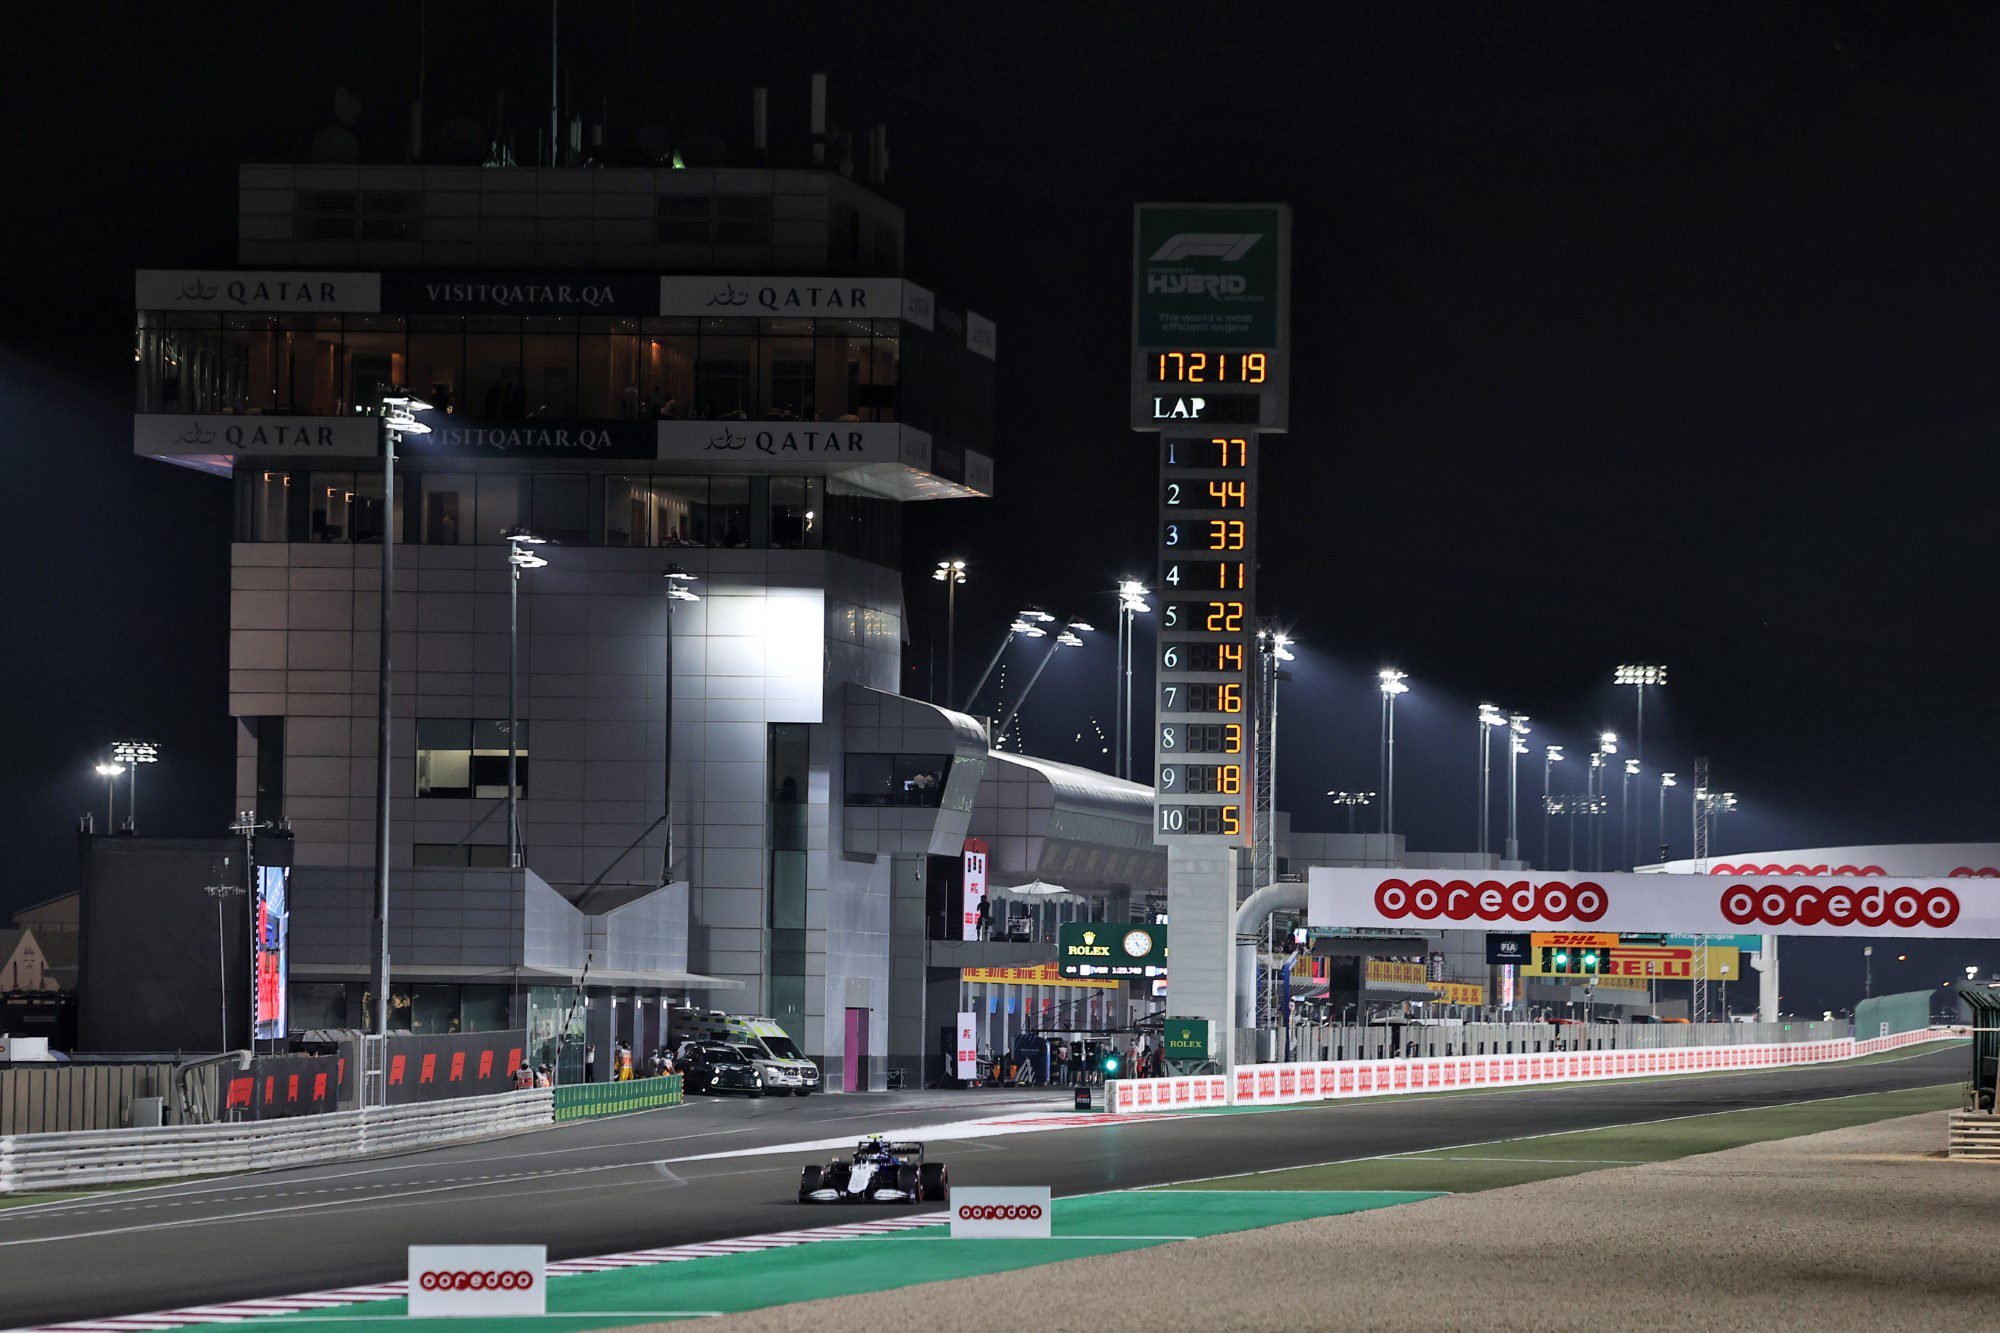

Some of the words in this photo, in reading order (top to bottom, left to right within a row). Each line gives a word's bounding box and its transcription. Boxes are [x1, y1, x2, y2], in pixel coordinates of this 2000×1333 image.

[227, 281, 337, 305] QATAR
[425, 282, 615, 305] VISITQATAR.QA
[758, 287, 867, 310] QATAR
[1148, 274, 1246, 301] HYBRID
[1153, 397, 1206, 418] LAP
[225, 425, 334, 448] QATAR
[424, 428, 612, 450] VISITQATAR.QA
[755, 431, 864, 454] QATAR
[1168, 443, 1176, 464] 1
[1212, 438, 1246, 467] 77
[1167, 484, 1180, 504] 2
[1209, 481, 1245, 508] 44
[1166, 525, 1178, 545] 3
[1210, 520, 1244, 550] 33
[1165, 565, 1180, 586] 4
[1220, 562, 1244, 589] 11
[1165, 606, 1177, 626] 5
[1207, 602, 1243, 631] 22
[1164, 647, 1177, 667] 6
[1218, 644, 1242, 670] 14
[1164, 687, 1177, 708] 7
[1218, 684, 1241, 713] 16
[1163, 728, 1175, 748] 8
[1225, 724, 1241, 754] 3
[1162, 768, 1175, 789] 9
[1217, 765, 1240, 794] 18
[1162, 809, 1182, 830] 10
[1223, 806, 1239, 835] 5
[1376, 879, 1607, 921] ooredoo
[1722, 885, 1958, 926] ooredoo
[1068, 946, 1110, 956] ROLEX
[1501, 943, 1516, 951] FIA
[1552, 935, 1598, 944] DHL
[958, 1204, 1042, 1220] ooredoo
[419, 1269, 534, 1291] ooredoo
